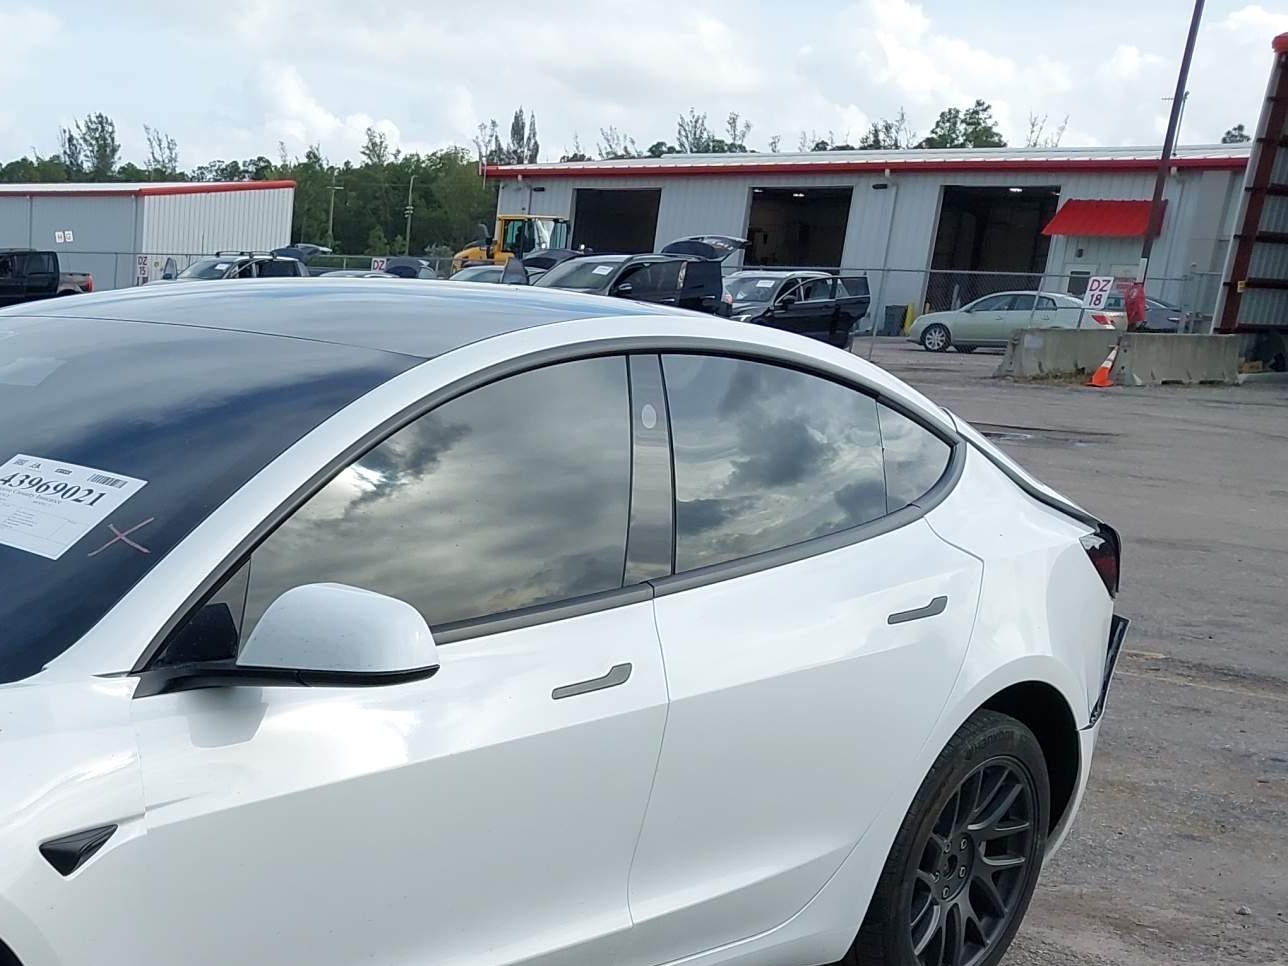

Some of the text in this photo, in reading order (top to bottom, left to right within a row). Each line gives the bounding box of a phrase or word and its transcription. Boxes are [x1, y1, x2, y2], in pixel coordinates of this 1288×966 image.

[1089, 279, 1111, 292] DZ
[1089, 294, 1103, 306] 18
[0, 472, 107, 507] 43969021
